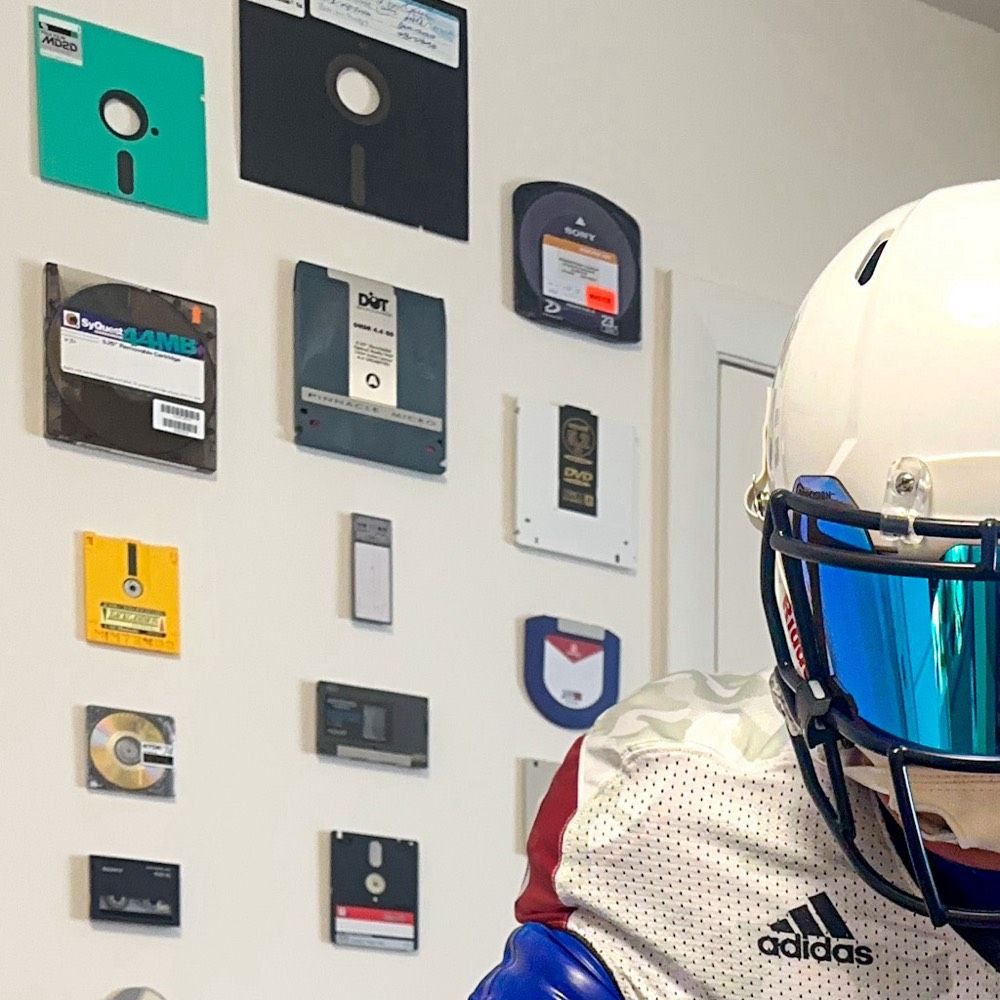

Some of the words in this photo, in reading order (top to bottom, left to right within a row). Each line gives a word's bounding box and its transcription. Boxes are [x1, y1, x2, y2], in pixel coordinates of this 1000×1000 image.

[564, 226, 597, 242] SONY
[81, 317, 123, 335] SyQuest
[564, 467, 594, 482] DVD
[757, 933, 874, 965] adidas
